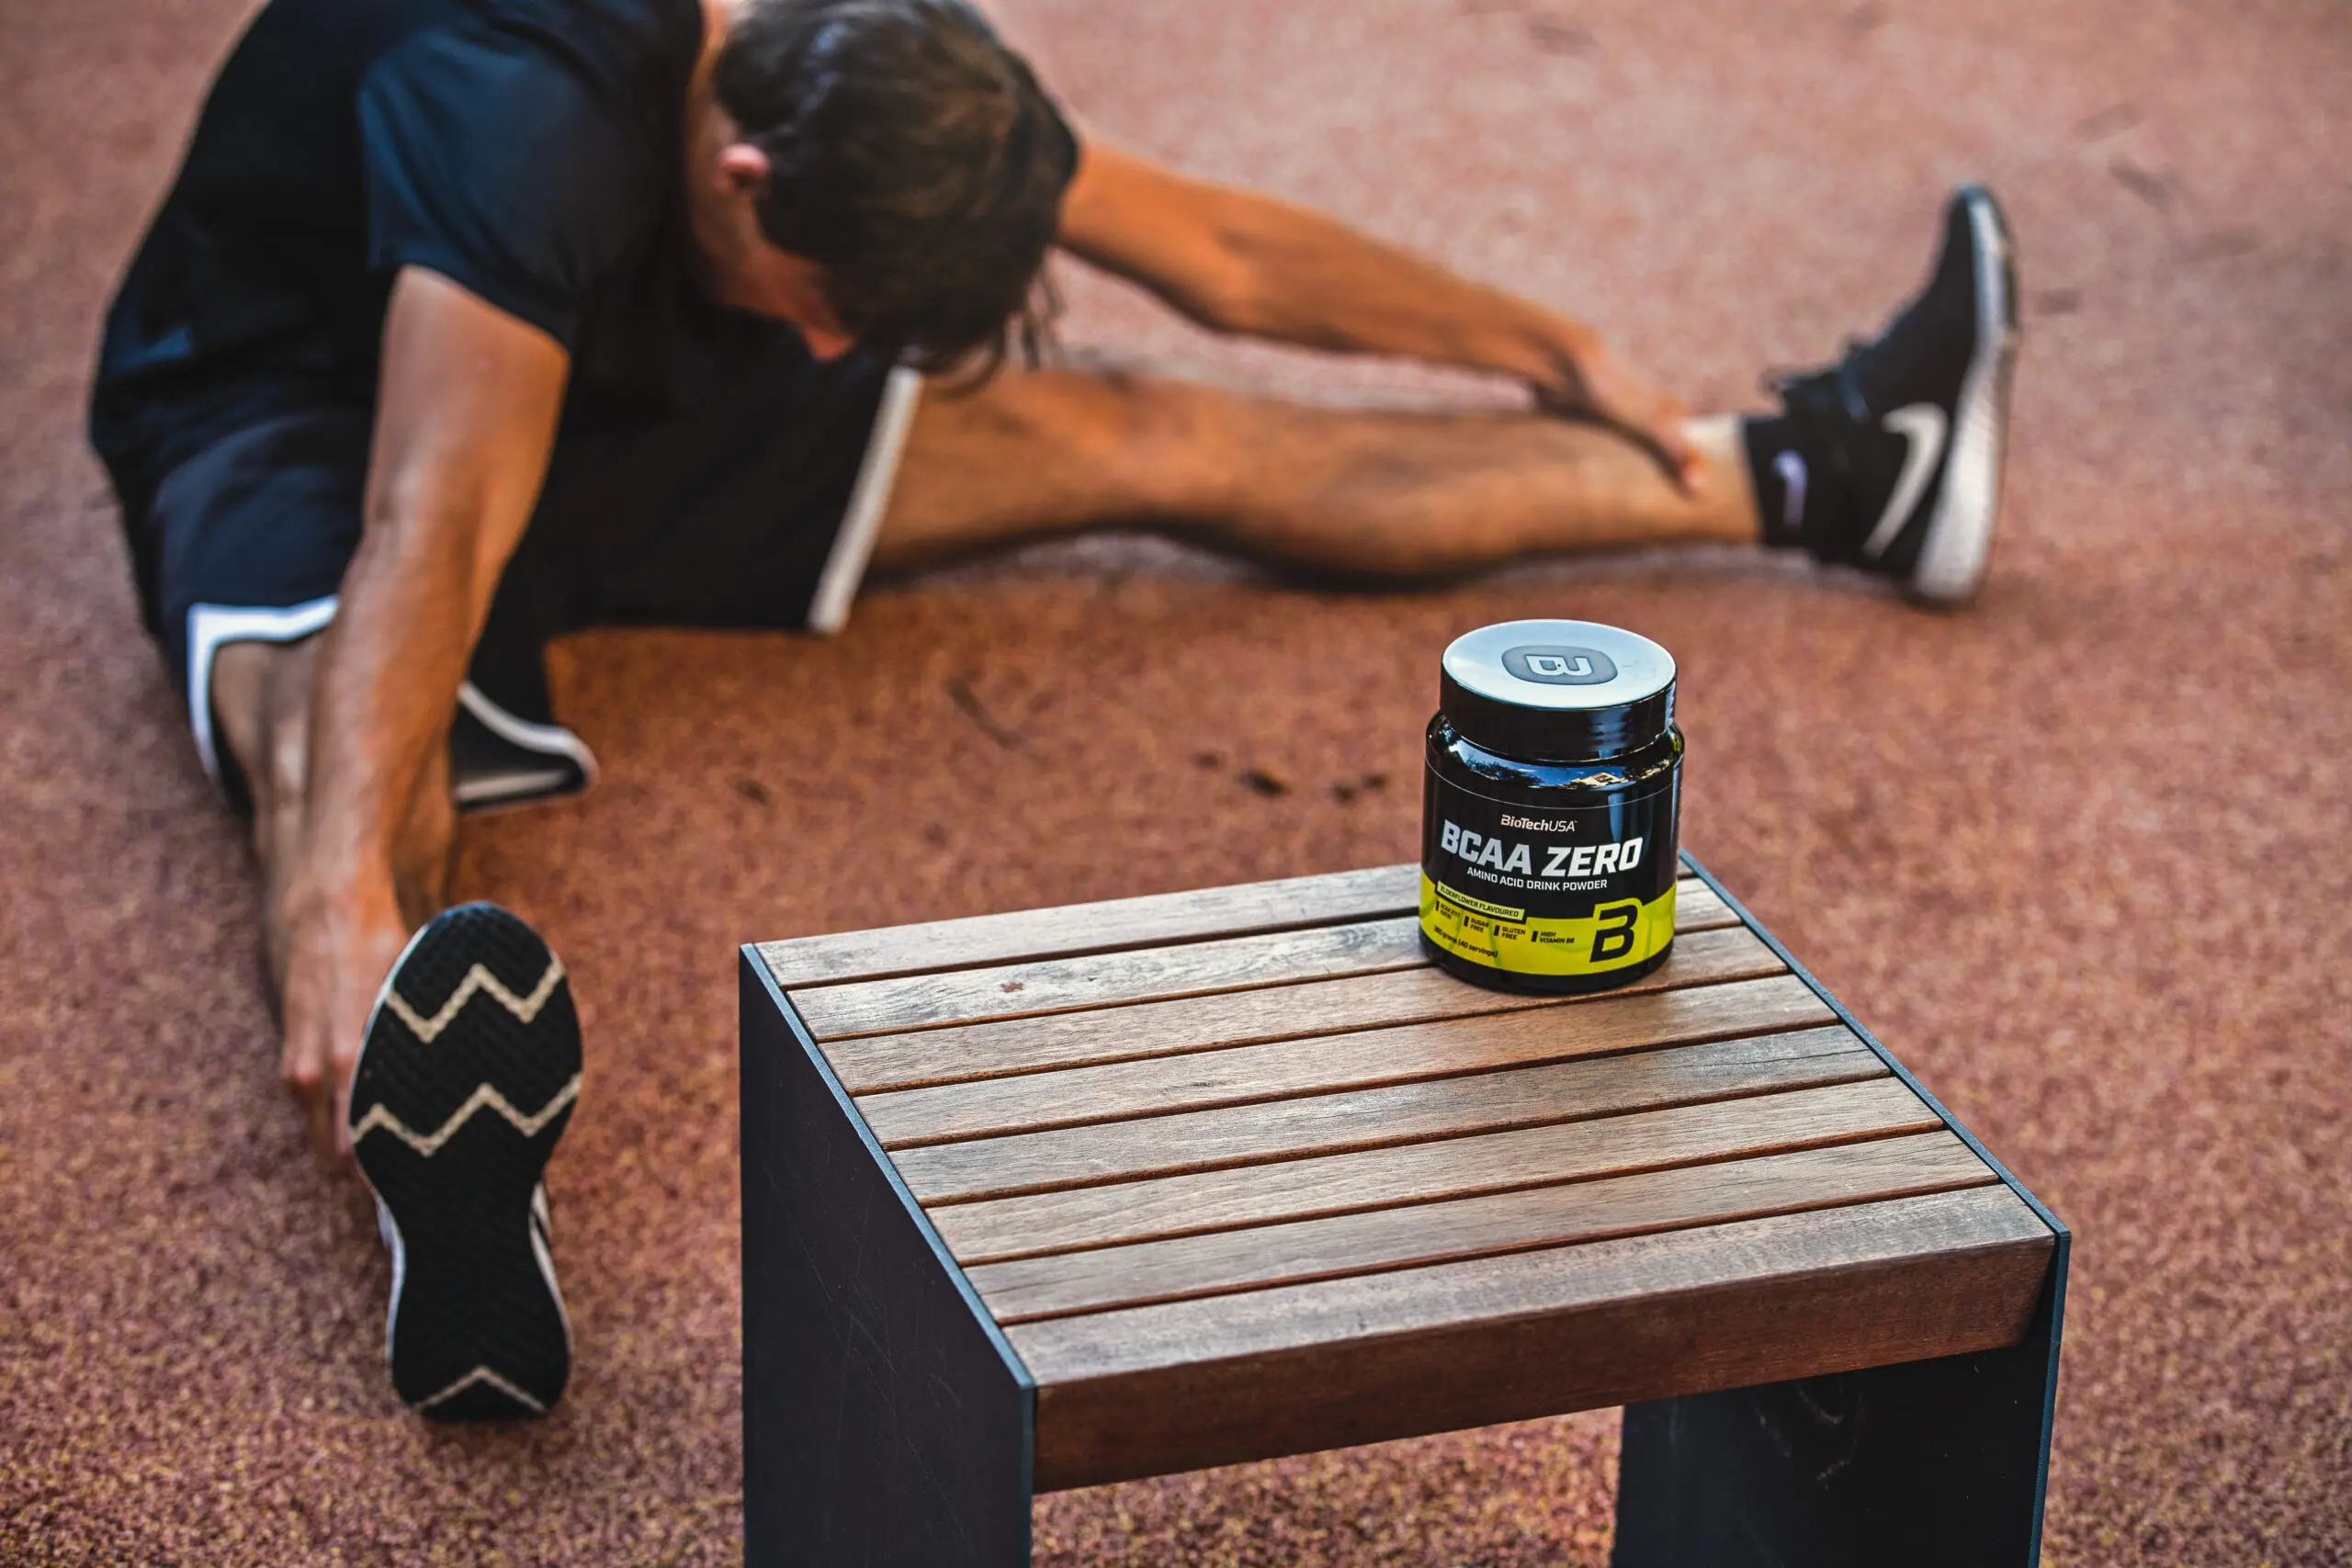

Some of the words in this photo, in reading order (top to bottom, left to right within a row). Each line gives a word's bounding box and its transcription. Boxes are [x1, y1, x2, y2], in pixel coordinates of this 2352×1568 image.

[1441, 819, 1532, 875] BCAA
[1541, 837, 1644, 877] ZERO
[1466, 866, 1498, 884] AMINO
[1499, 875, 1524, 888] ACID
[1526, 879, 1561, 891] DRINK
[1563, 878, 1608, 891] POWDER
[1440, 885, 1479, 908] ELDERFLOWER
[1479, 902, 1520, 918] FLAVOURED
[1470, 918, 1489, 928] SUGAR
[1470, 924, 1485, 933] FREE
[1502, 926, 1526, 935] GLUTEN
[1501, 932, 1518, 941] FREE
